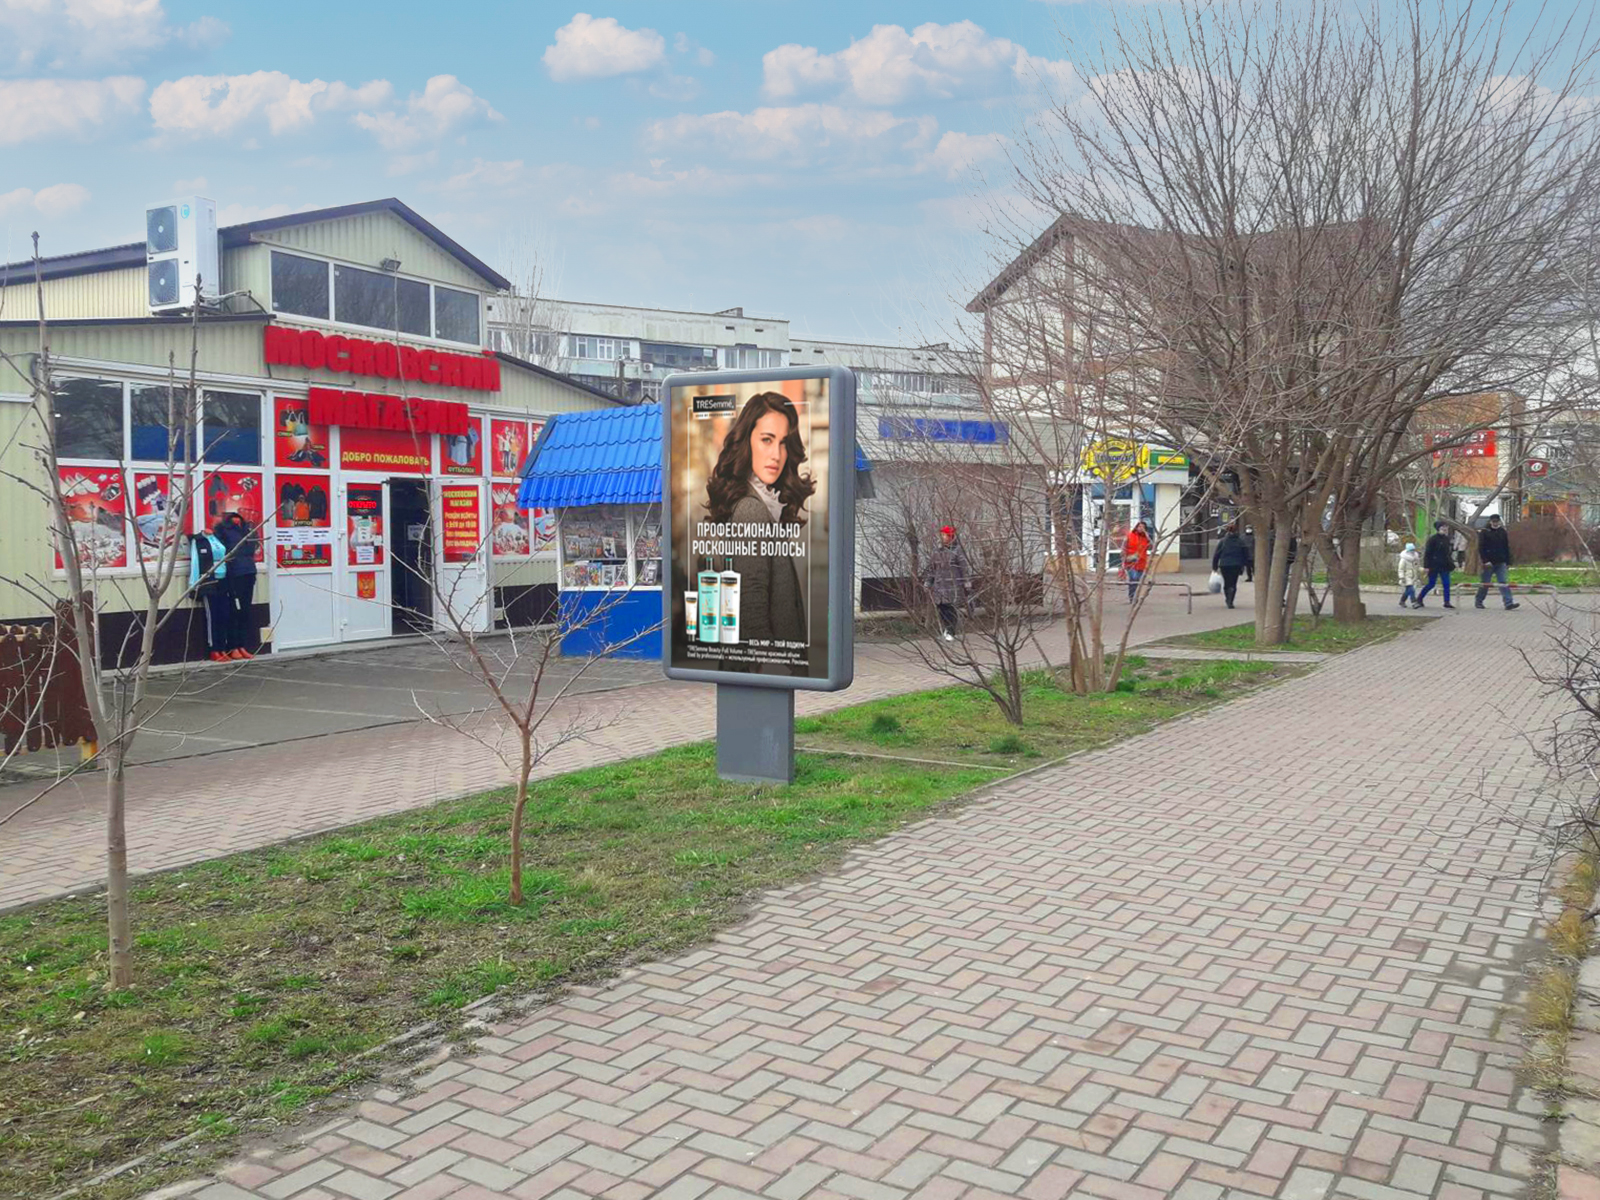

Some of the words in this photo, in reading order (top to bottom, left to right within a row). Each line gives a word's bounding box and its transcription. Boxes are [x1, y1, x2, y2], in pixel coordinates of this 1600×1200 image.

[264, 325, 501, 391] МОСКОВСКИЙ
[308, 386, 468, 436] МАГАЗИН
[342, 451, 372, 462] ДОБРО
[374, 453, 430, 466] ПОЖАЛОВАТЬ
[697, 522, 800, 539] ПРОФЕССИОНАЛЬНО
[692, 540, 758, 556] РОСКОШНЫЕ
[760, 541, 806, 557] ВОЛОСЫ
